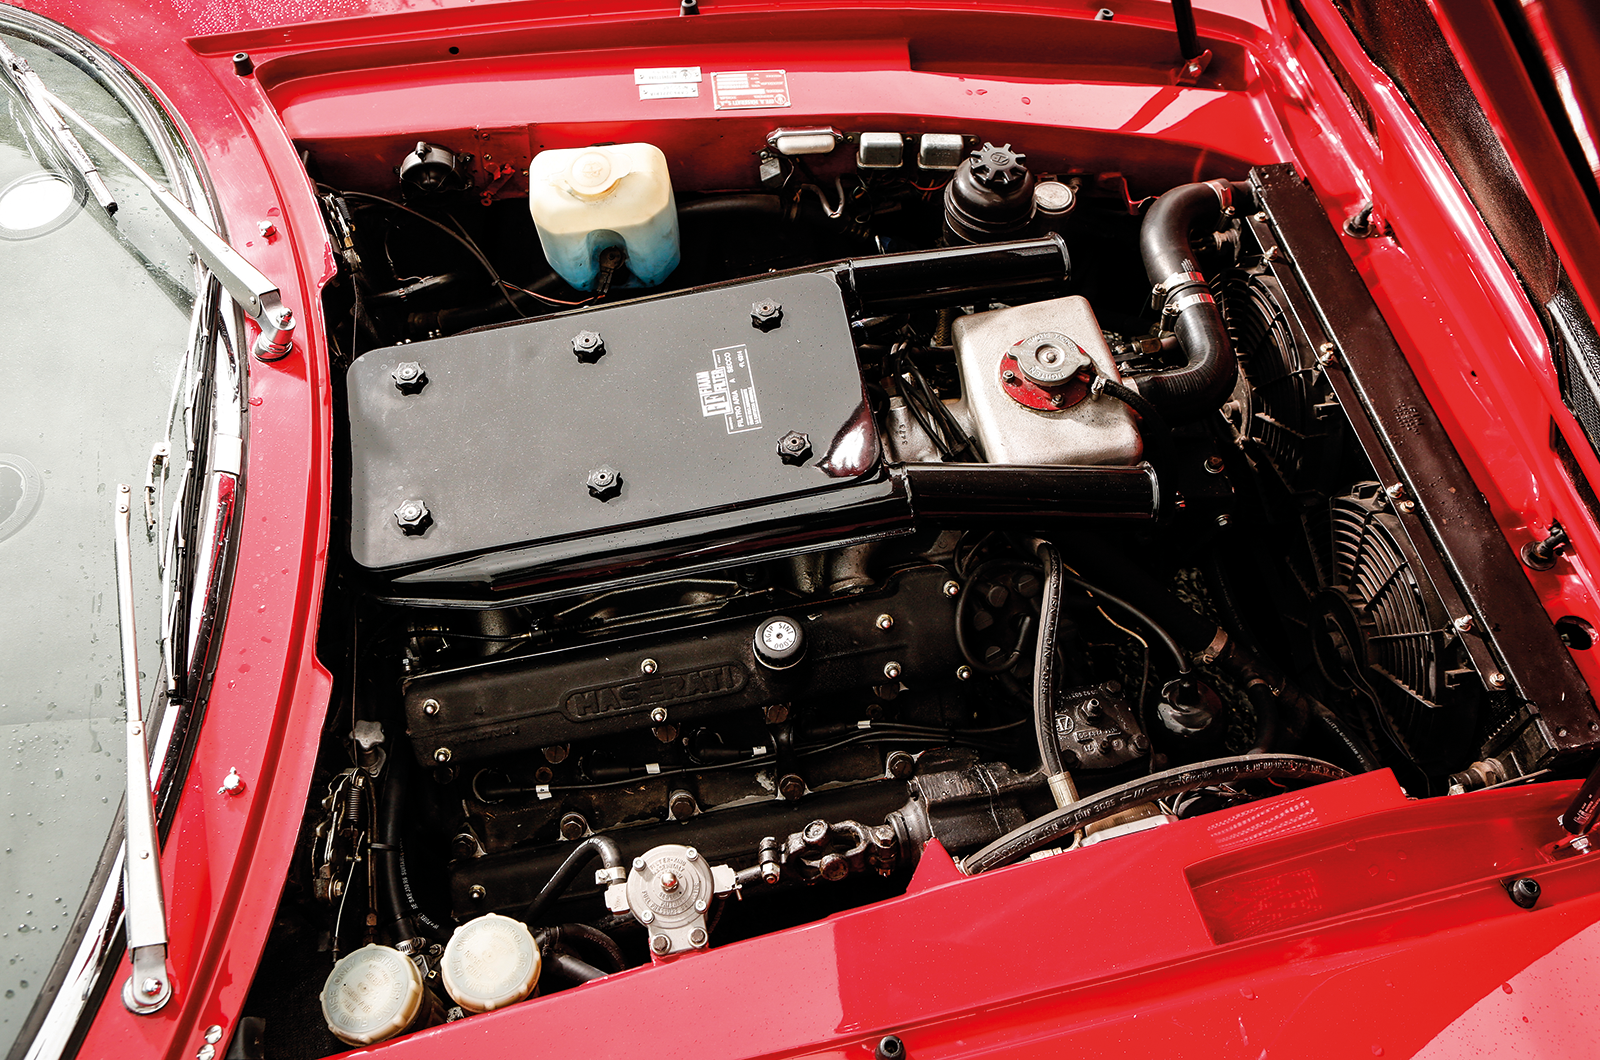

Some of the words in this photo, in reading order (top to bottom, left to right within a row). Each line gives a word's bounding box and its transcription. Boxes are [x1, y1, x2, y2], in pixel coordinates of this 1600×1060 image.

[724, 352, 734, 374] SECCO
[1028, 366, 1066, 380] TIGHTEN
[696, 370, 712, 394] FIAAM
[710, 368, 727, 392] FILTER
[732, 390, 741, 404] ARIA
[734, 406, 745, 428] FILTRO
[774, 638, 793, 649] 2000
[1044, 637, 1053, 658] DIN
[574, 664, 735, 716] MASERATI
[454, 926, 477, 952] ONLY
[482, 922, 525, 948] CASTROL
[334, 958, 356, 985] ONLY
[361, 953, 401, 978] CASTROL
[451, 956, 464, 978] USE
[464, 978, 496, 994] FLUID
[329, 988, 340, 1013] USE
[374, 982, 403, 1021] GIRLING
[338, 1012, 369, 1028] FLUID
